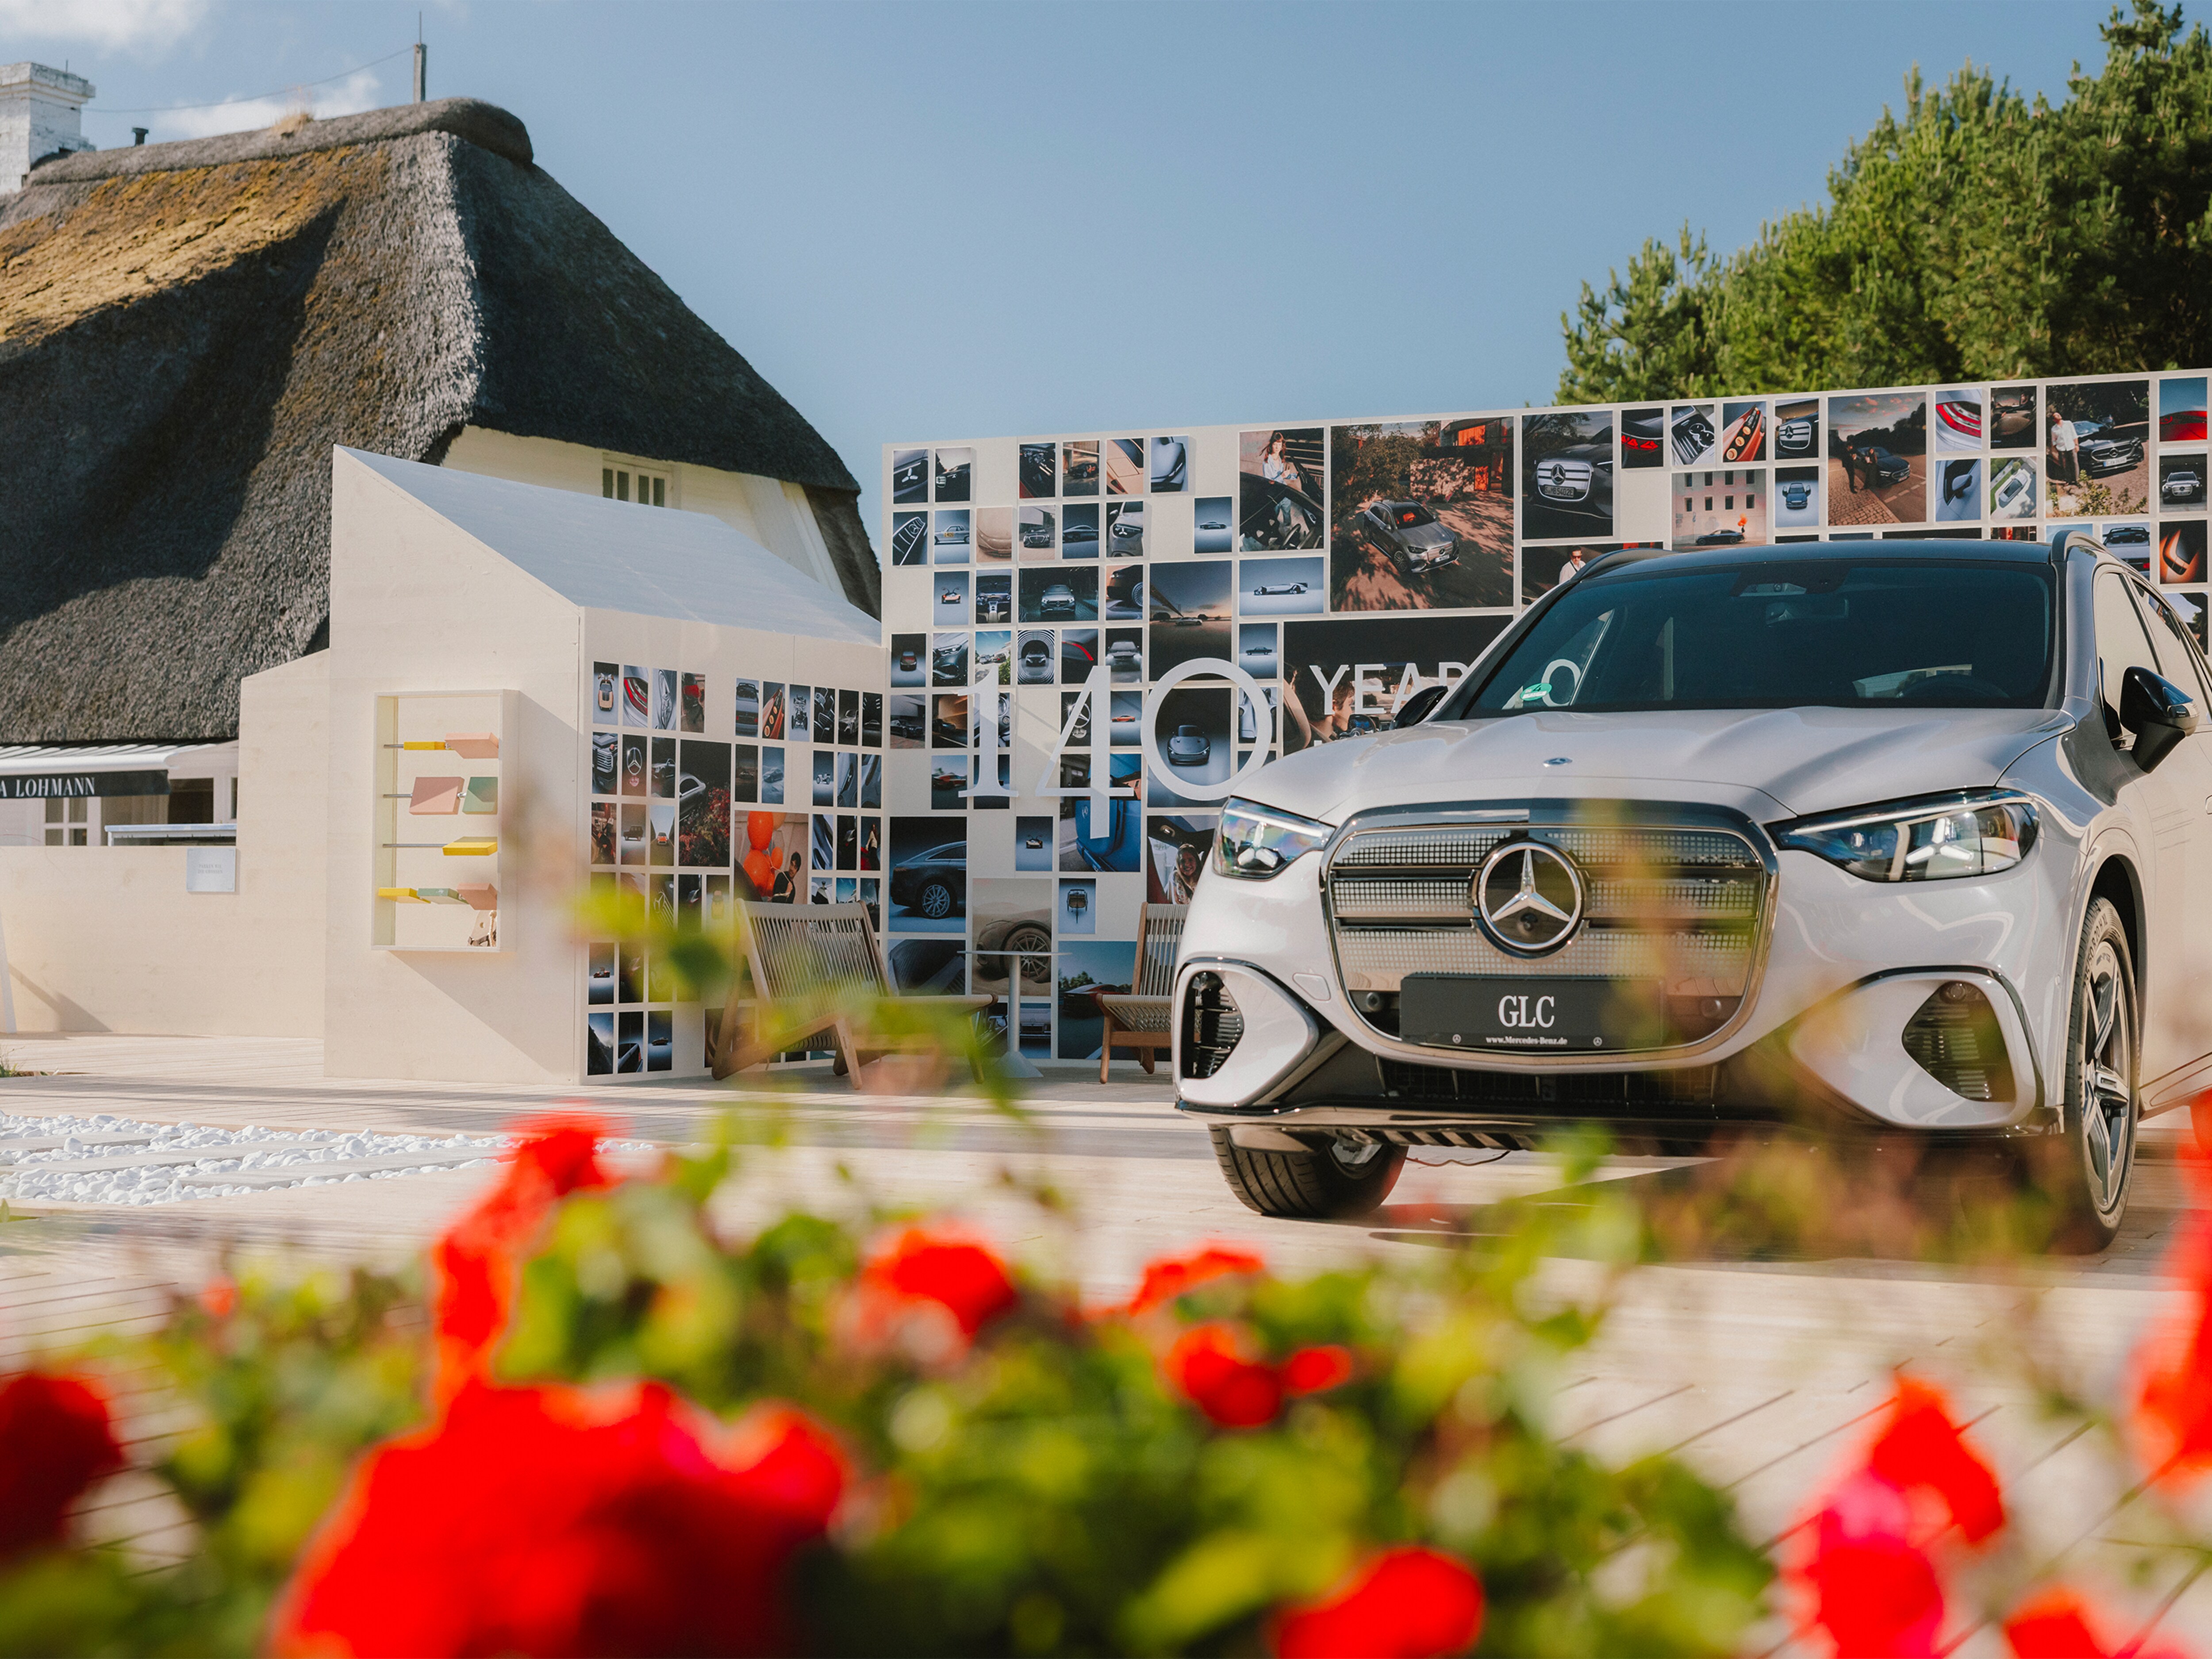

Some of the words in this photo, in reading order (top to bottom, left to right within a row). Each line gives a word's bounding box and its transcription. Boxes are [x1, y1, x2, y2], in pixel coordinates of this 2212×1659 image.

[957, 658, 1273, 839] 140
[16, 777, 95, 797] LOHMANN
[1498, 995, 1554, 1028] GLC
[1486, 1036, 1567, 1045] www.Mercedes-Benz.de
